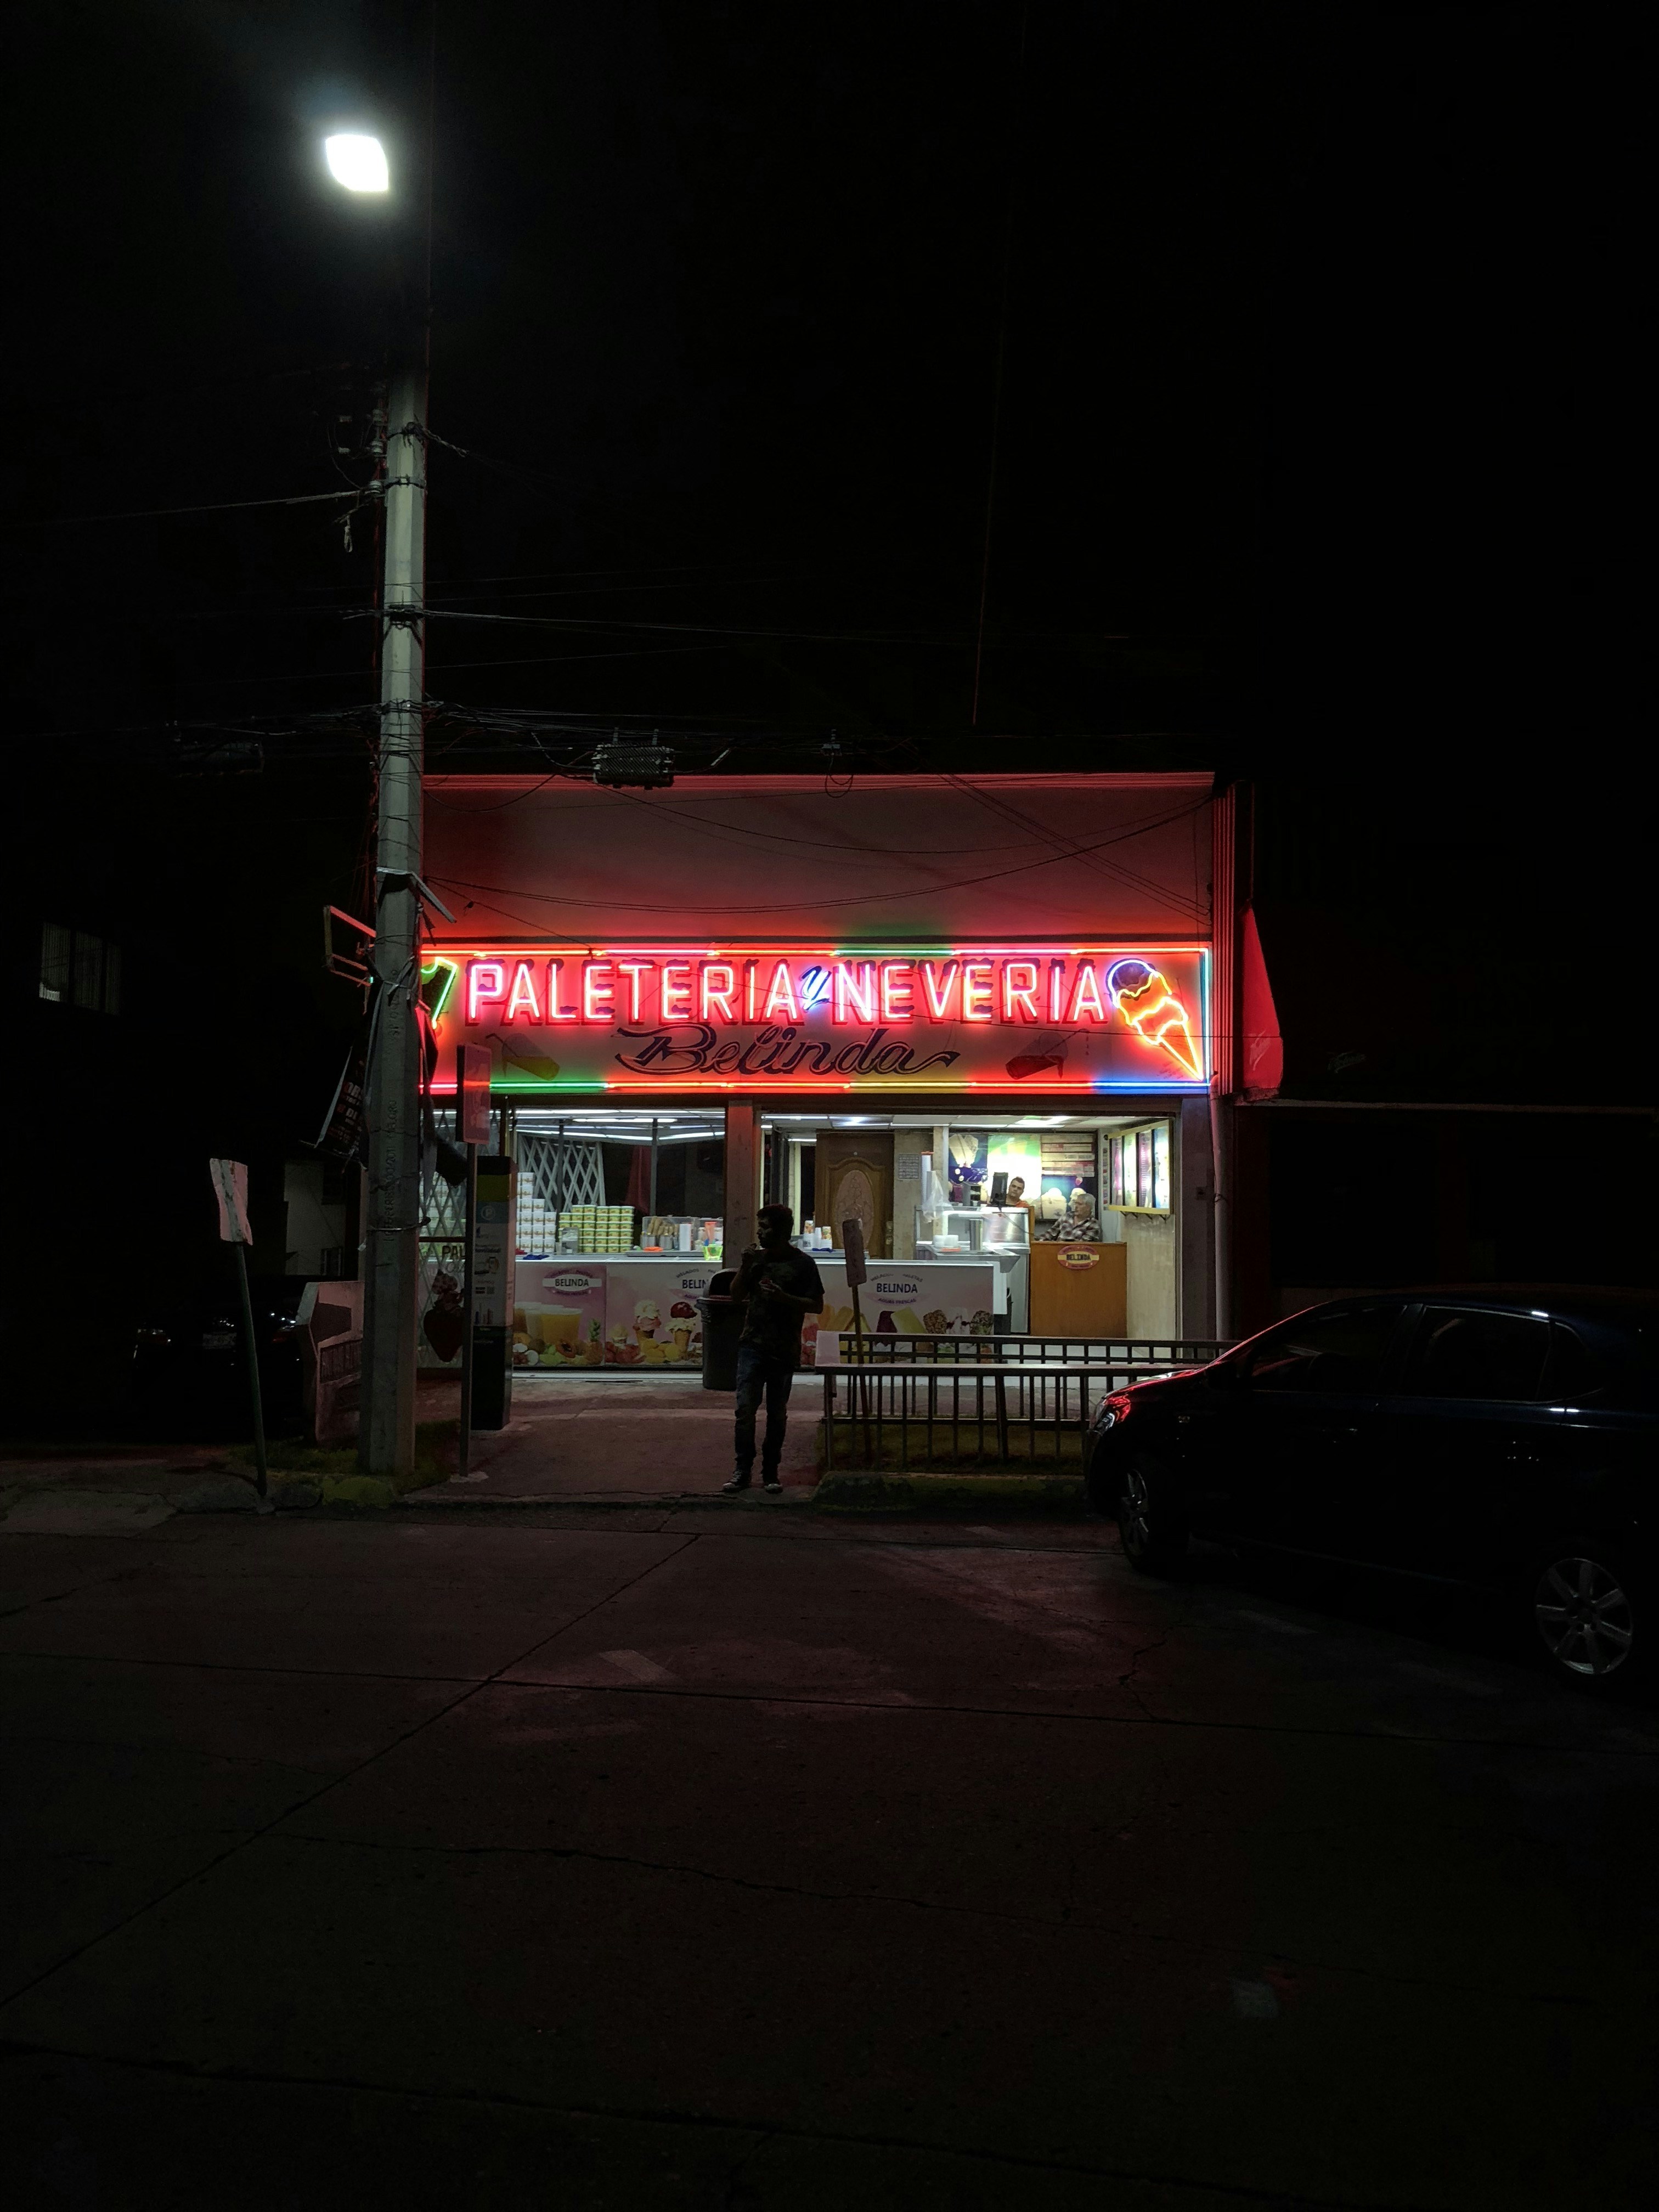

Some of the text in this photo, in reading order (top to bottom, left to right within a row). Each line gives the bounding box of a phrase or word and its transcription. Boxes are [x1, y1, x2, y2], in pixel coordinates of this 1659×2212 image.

[467, 960, 803, 1025] PALETERIA
[832, 959, 1108, 1024] NEVERIA
[612, 1022, 961, 1075] Belinda
[555, 1278, 589, 1286] BELINDA
[877, 1283, 918, 1293] BELINDA
